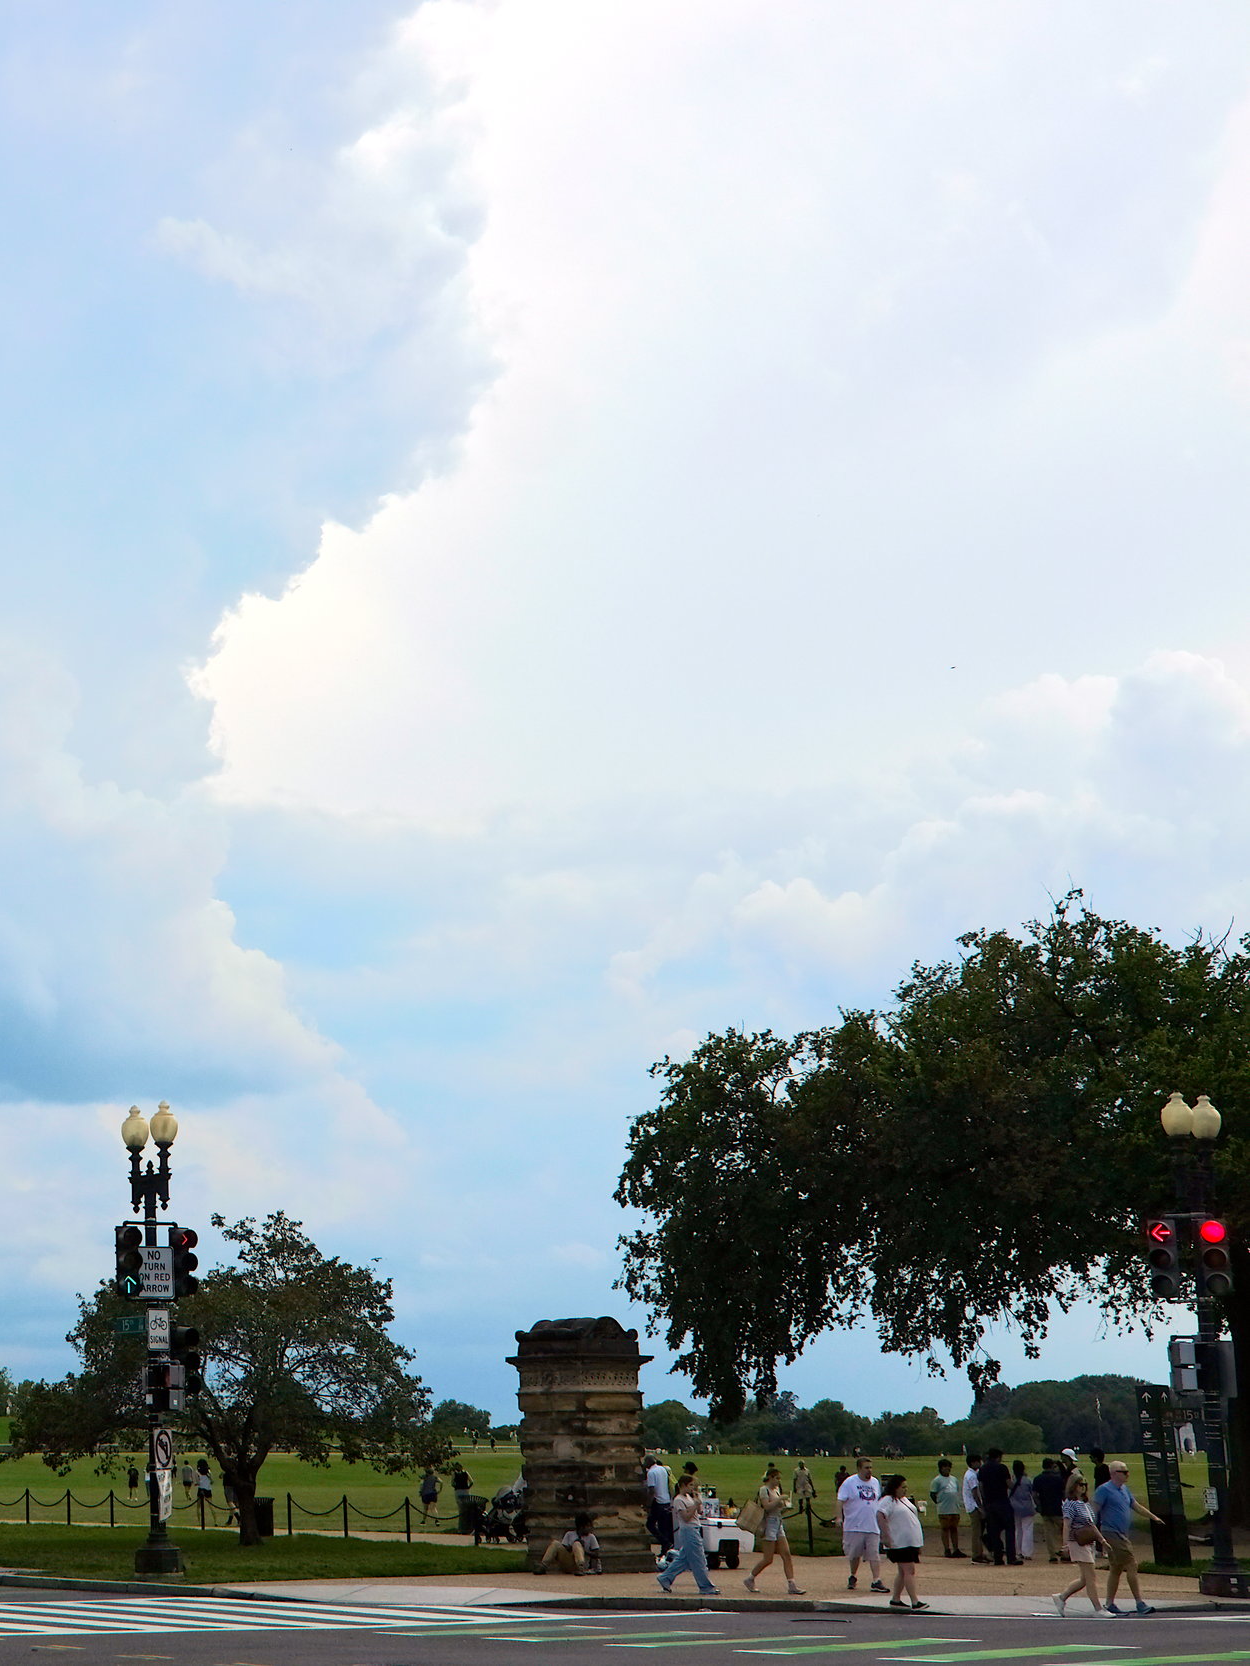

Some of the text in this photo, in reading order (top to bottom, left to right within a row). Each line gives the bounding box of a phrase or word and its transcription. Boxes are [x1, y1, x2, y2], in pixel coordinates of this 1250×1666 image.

[147, 1250, 160, 1260] NO
[144, 1262, 165, 1270] TURN
[154, 1272, 170, 1281] RED
[143, 1284, 169, 1292] ARROW
[150, 1335, 169, 1344] SIGNAL
